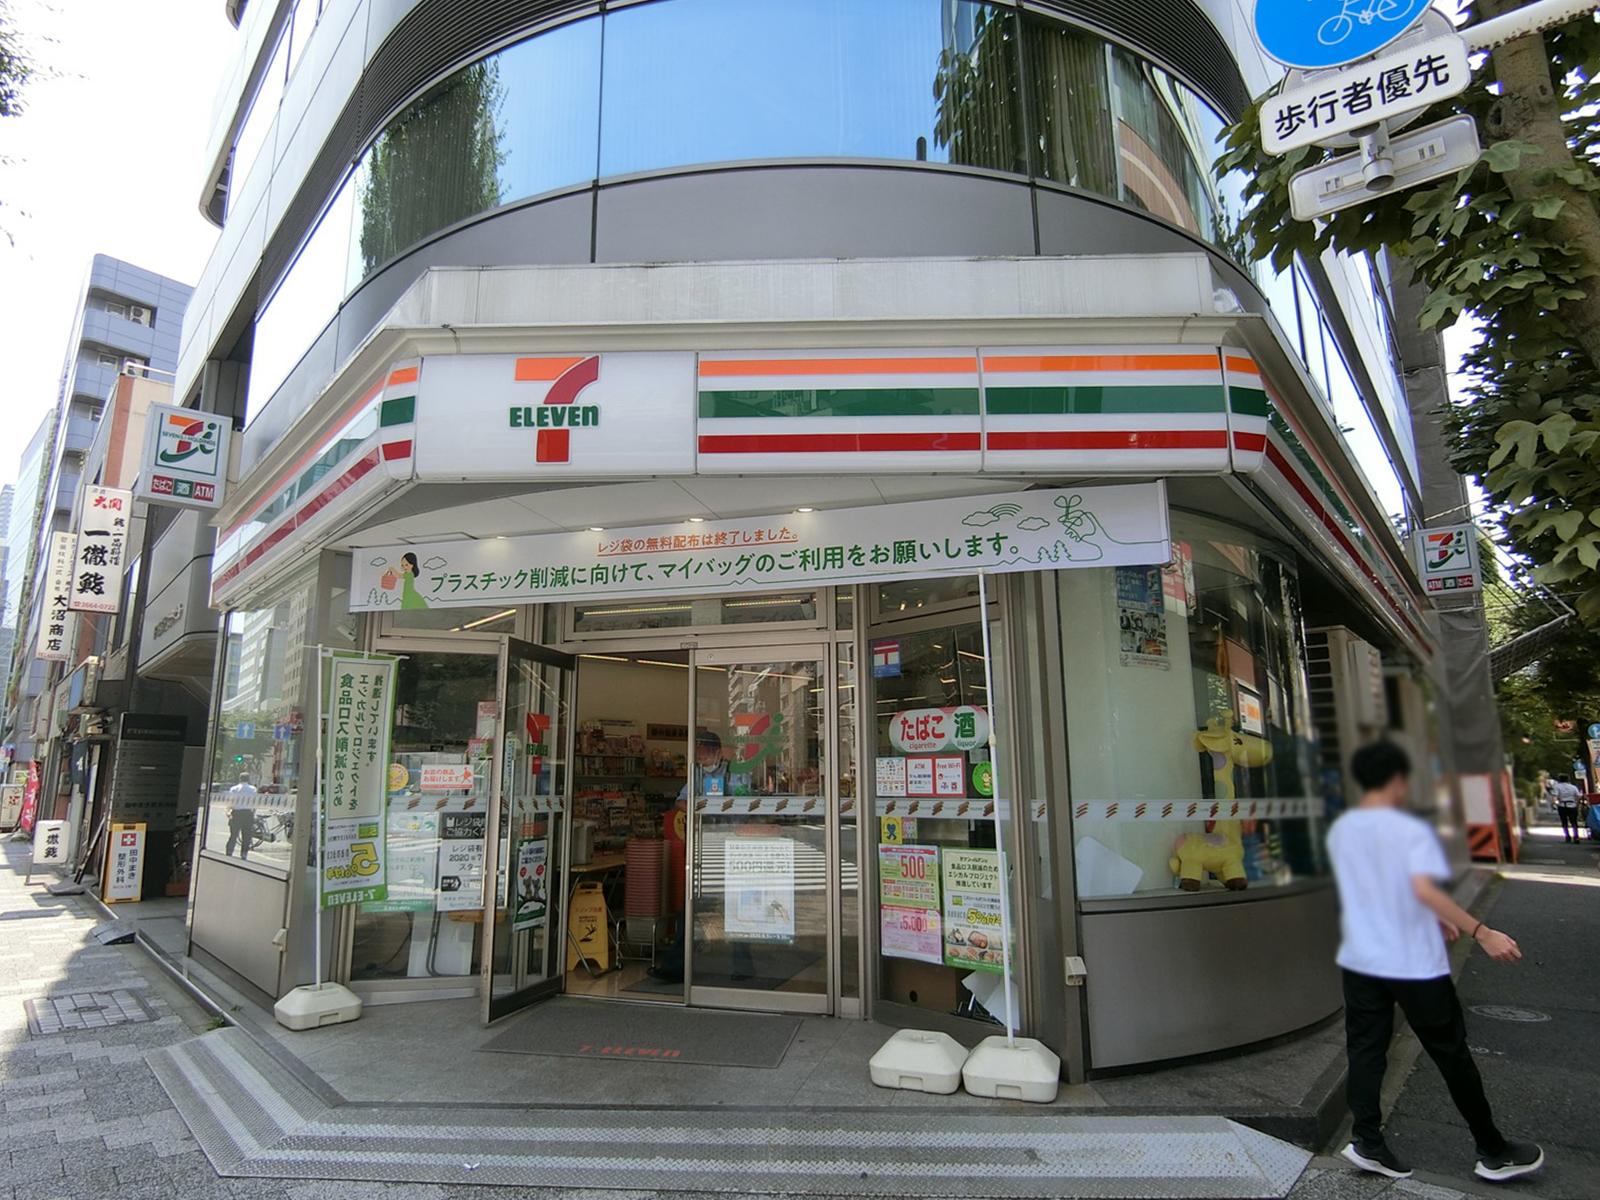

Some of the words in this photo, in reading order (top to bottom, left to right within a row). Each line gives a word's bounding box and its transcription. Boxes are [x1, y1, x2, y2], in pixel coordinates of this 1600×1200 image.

[1275, 54, 1450, 140] 歩行者優先
[153, 478, 173, 492] たばこ
[176, 481, 190, 495] 酒
[194, 485, 214, 498] ATM
[597, 526, 799, 553] レジ袋の無料配布は終了しました。
[430, 532, 1020, 594] プラスチック削減に向けて、マイバッグのご利用をお願いします。
[46, 595, 68, 652] 大沼商店
[900, 714, 946, 741] たばこ
[954, 712, 976, 739] 酒
[909, 742, 937, 751] cigarette
[914, 762, 925, 770] ATM
[116, 852, 127, 884] 整形外科
[128, 849, 138, 880] 田中まき
[900, 855, 926, 879] 500
